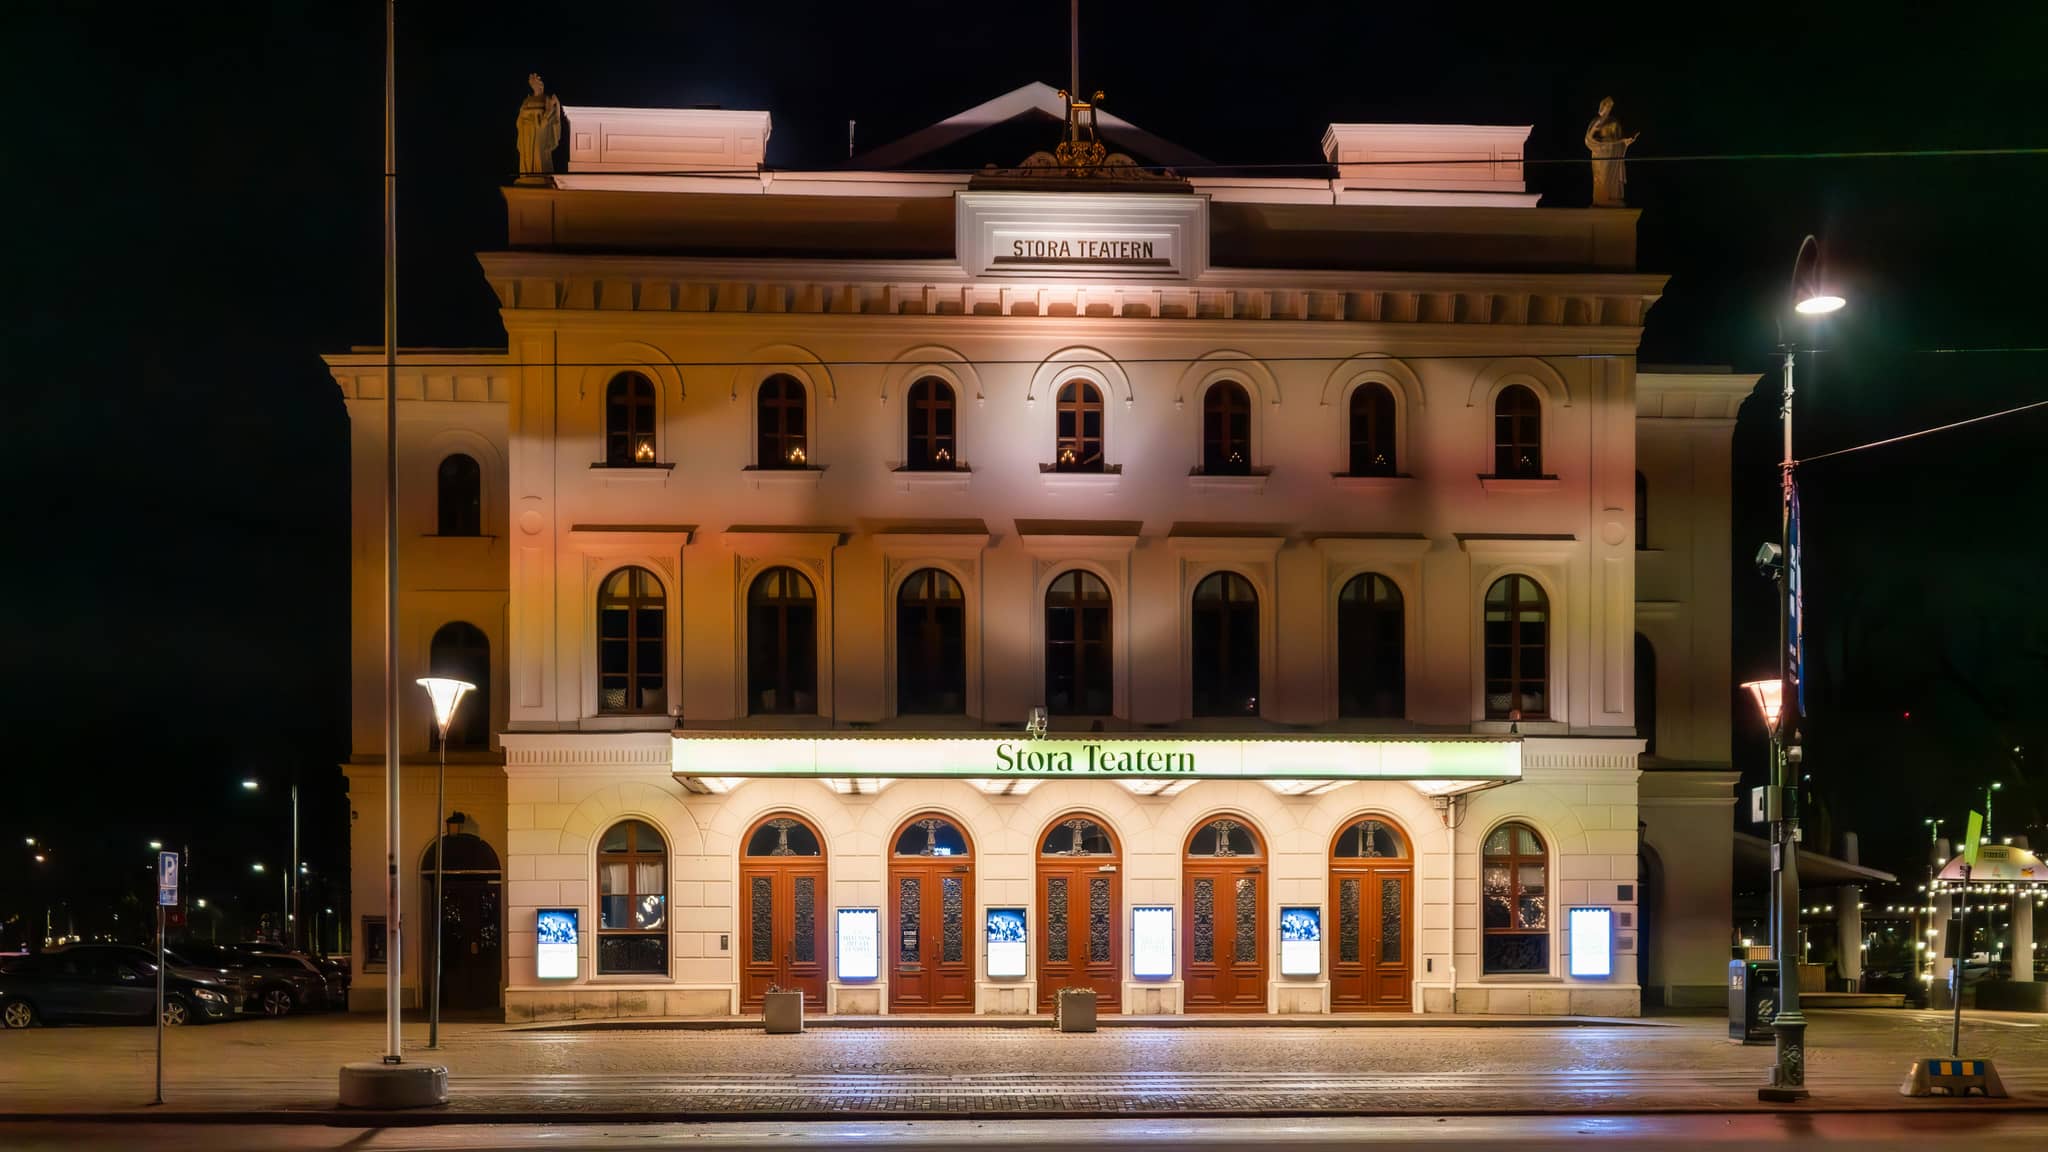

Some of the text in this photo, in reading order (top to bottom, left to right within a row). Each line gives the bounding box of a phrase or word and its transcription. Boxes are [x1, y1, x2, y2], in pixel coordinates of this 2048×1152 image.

[1013, 240, 1153, 258] STORA TEATERN
[996, 743, 1196, 772] Stora Teatern
[165, 856, 175, 884] P
